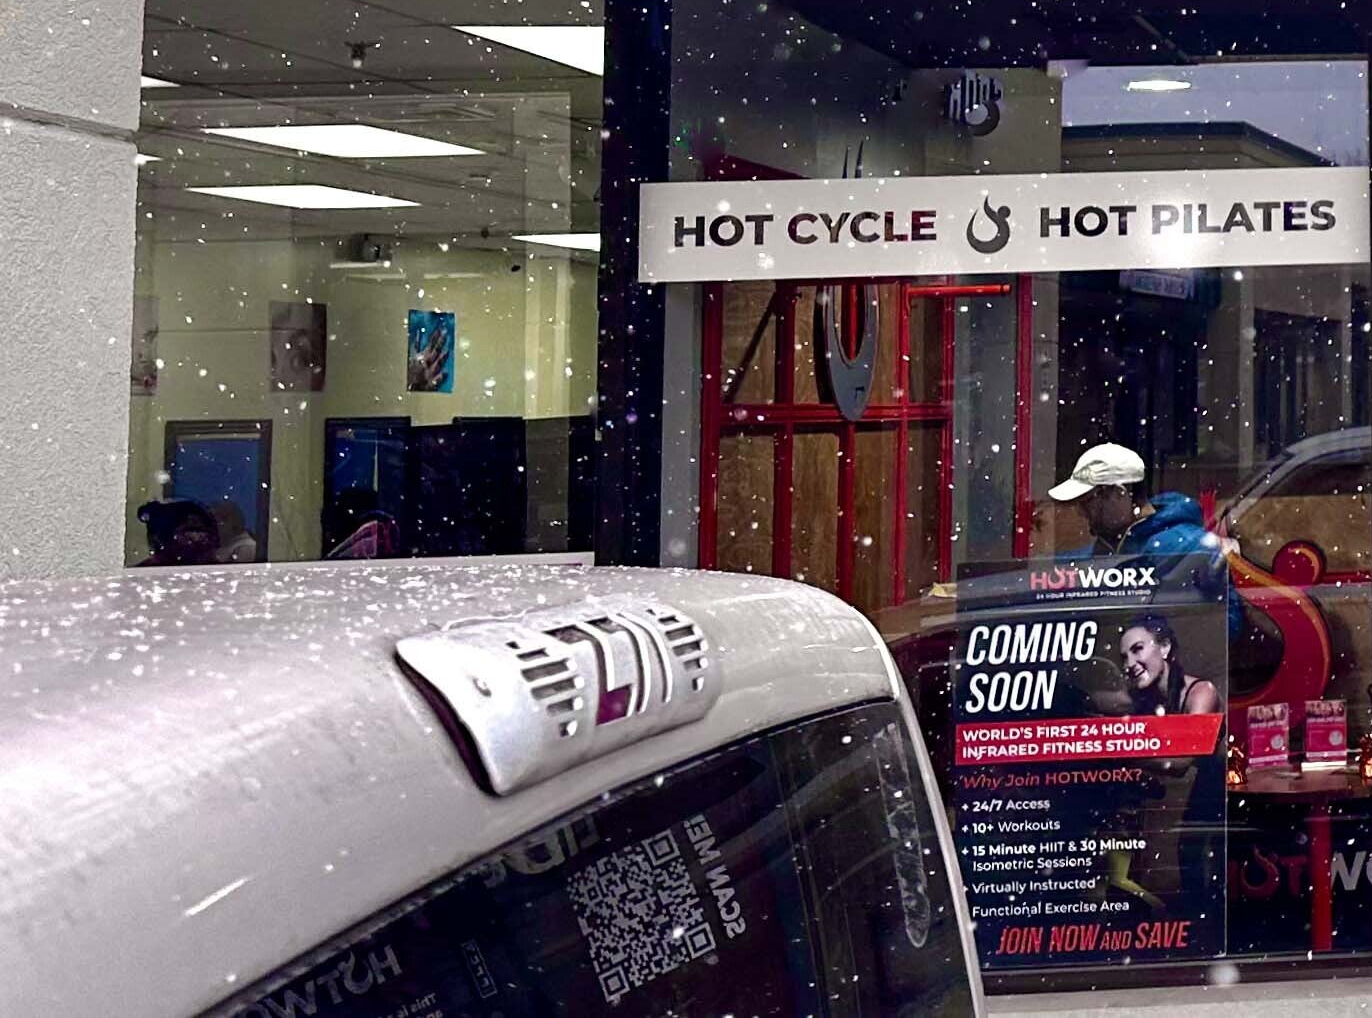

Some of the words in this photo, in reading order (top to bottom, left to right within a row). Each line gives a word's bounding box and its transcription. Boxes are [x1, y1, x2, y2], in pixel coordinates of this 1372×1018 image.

[673, 213, 774, 248] HOT
[787, 210, 937, 244] CYCLE
[1040, 205, 1138, 238] HOT
[1151, 199, 1337, 236] PILATES
[1030, 567, 1156, 590] HOTWORX
[965, 620, 1098, 666] COMING
[965, 669, 1058, 713] SOON
[962, 727, 1033, 742] WORLD'S
[1036, 725, 1078, 739] FIRST
[1081, 724, 1098, 736] 24
[1101, 722, 1146, 735] HOUR
[962, 744, 1039, 759] INFRARED
[1042, 740, 1103, 755] FITNESS
[1106, 737, 1161, 752] STUDIO
[963, 774, 1003, 790] Why
[1004, 773, 1040, 788] Join
[1045, 768, 1143, 784] HOTWORX?
[972, 799, 1003, 813] 24/7
[1005, 798, 1051, 810] Access
[972, 822, 994, 834] 10+
[998, 819, 1061, 832] Workouts
[972, 845, 986, 856] 15
[989, 843, 1037, 855] Minute
[1039, 841, 1065, 853] HIIT
[1068, 841, 1078, 852] &
[1080, 839, 1097, 851] 30
[1100, 837, 1147, 851] Minute
[972, 858, 1034, 872] Isometric
[1037, 856, 1092, 868] Sessions
[971, 881, 1027, 895] Virtually
[1029, 878, 1096, 891] Instructed
[972, 902, 1041, 917] Functional
[1045, 901, 1097, 914] Exercise
[1099, 900, 1130, 911] Area
[996, 926, 1044, 955] JOIN
[1048, 923, 1101, 952] NOW
[1100, 930, 1132, 951] AND
[1135, 921, 1191, 949] SAVE
